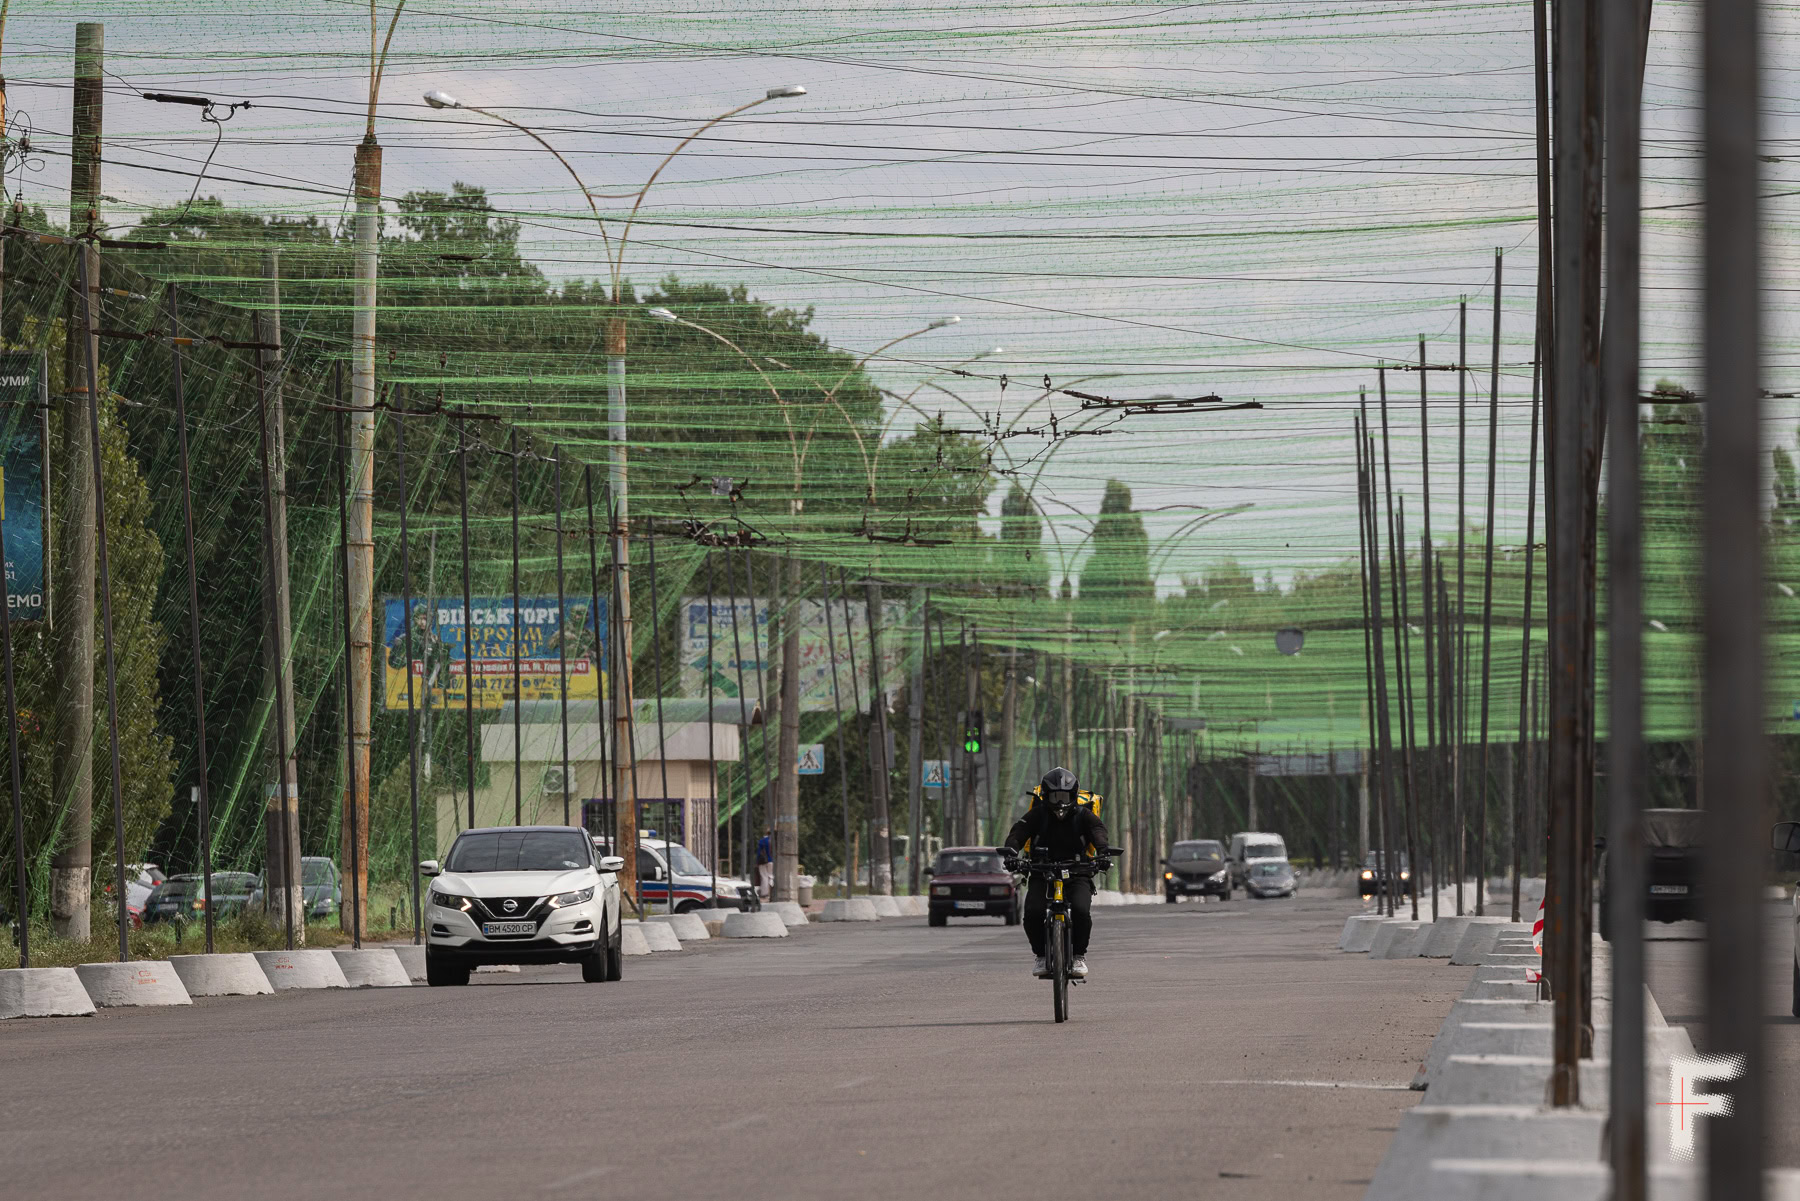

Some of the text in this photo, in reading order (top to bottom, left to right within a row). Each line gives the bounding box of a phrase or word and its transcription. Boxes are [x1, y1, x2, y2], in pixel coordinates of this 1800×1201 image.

[0, 375, 29, 387] УМИ
[489, 924, 533, 933] BM 4520 CP
